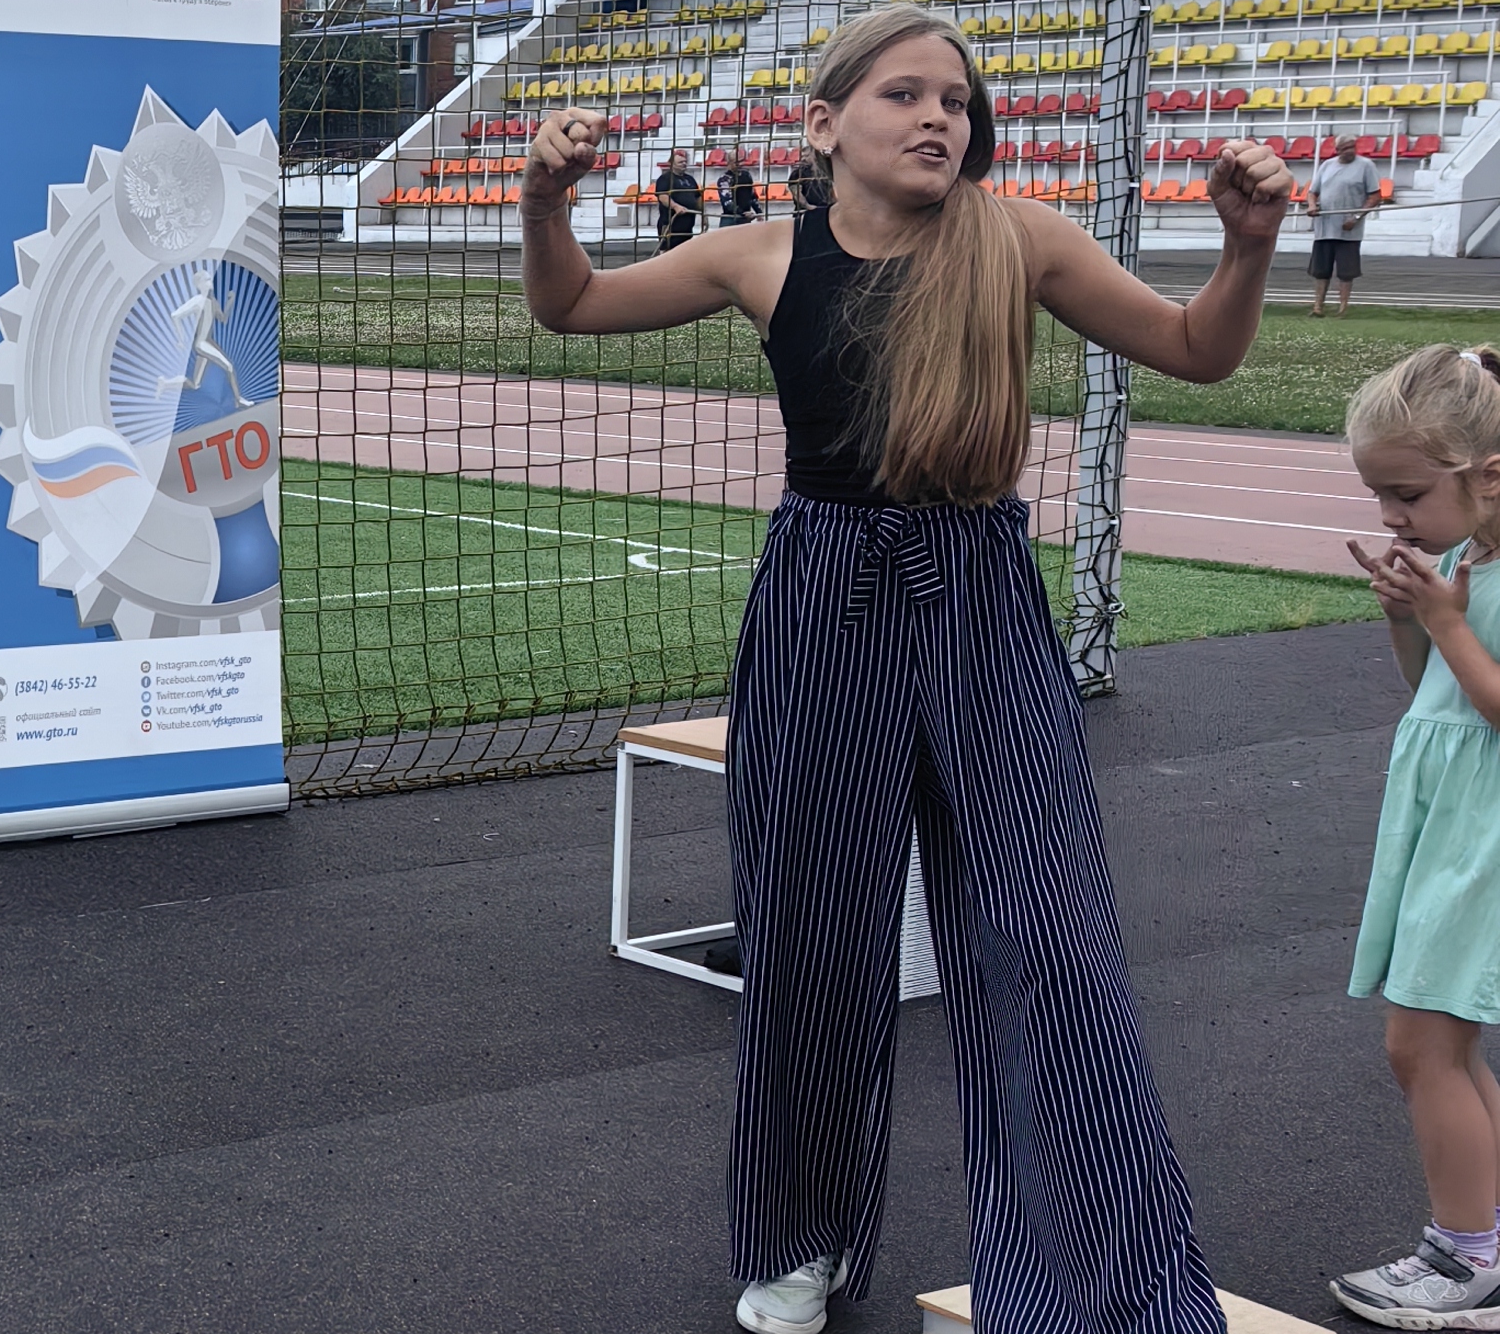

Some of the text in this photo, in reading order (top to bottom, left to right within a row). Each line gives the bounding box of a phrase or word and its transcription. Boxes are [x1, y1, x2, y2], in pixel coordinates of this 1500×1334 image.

[178, 420, 271, 494] ГТО
[14, 675, 98, 696] (3842) 46-55-22
[15, 727, 78, 741] www.gto.ru
